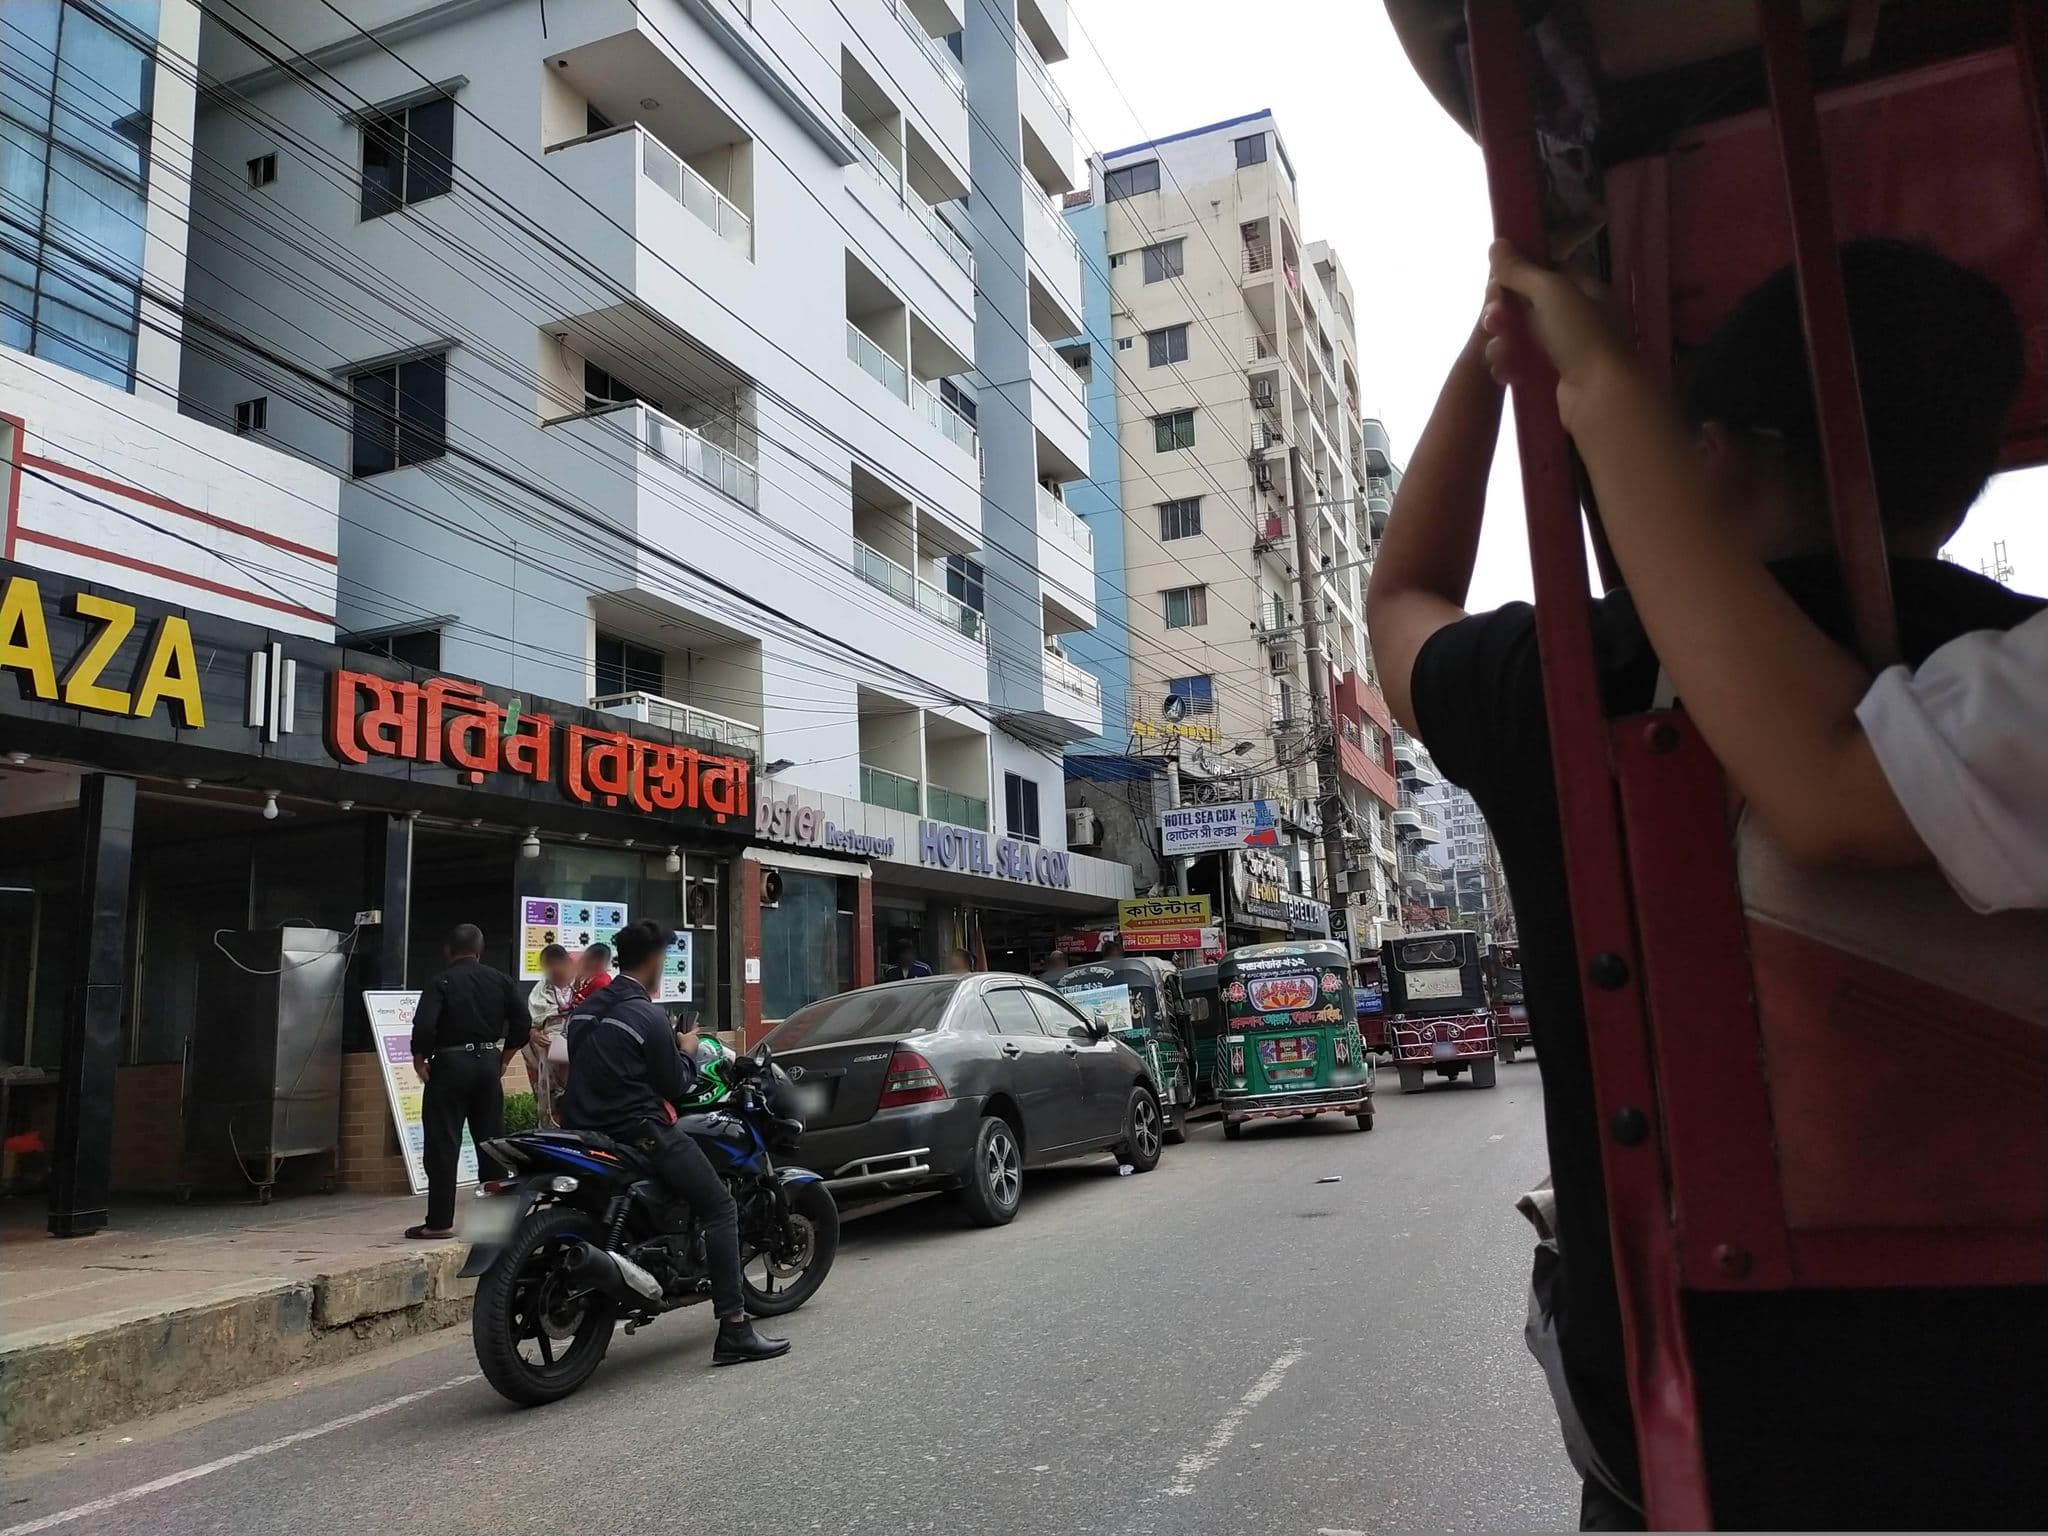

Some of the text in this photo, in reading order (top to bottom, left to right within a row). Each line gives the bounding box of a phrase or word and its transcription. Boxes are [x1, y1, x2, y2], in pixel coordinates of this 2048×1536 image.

[0, 576, 205, 728] AZA
[332, 670, 555, 784] মেরিন
[1165, 808, 1236, 827] HOTEL SEA COX
[1166, 828, 1198, 842] হোটেল
[825, 821, 894, 856] Restaurant
[919, 820, 1072, 888] HOTEL SEA COX
[1122, 900, 1203, 917] কাউন্টার
